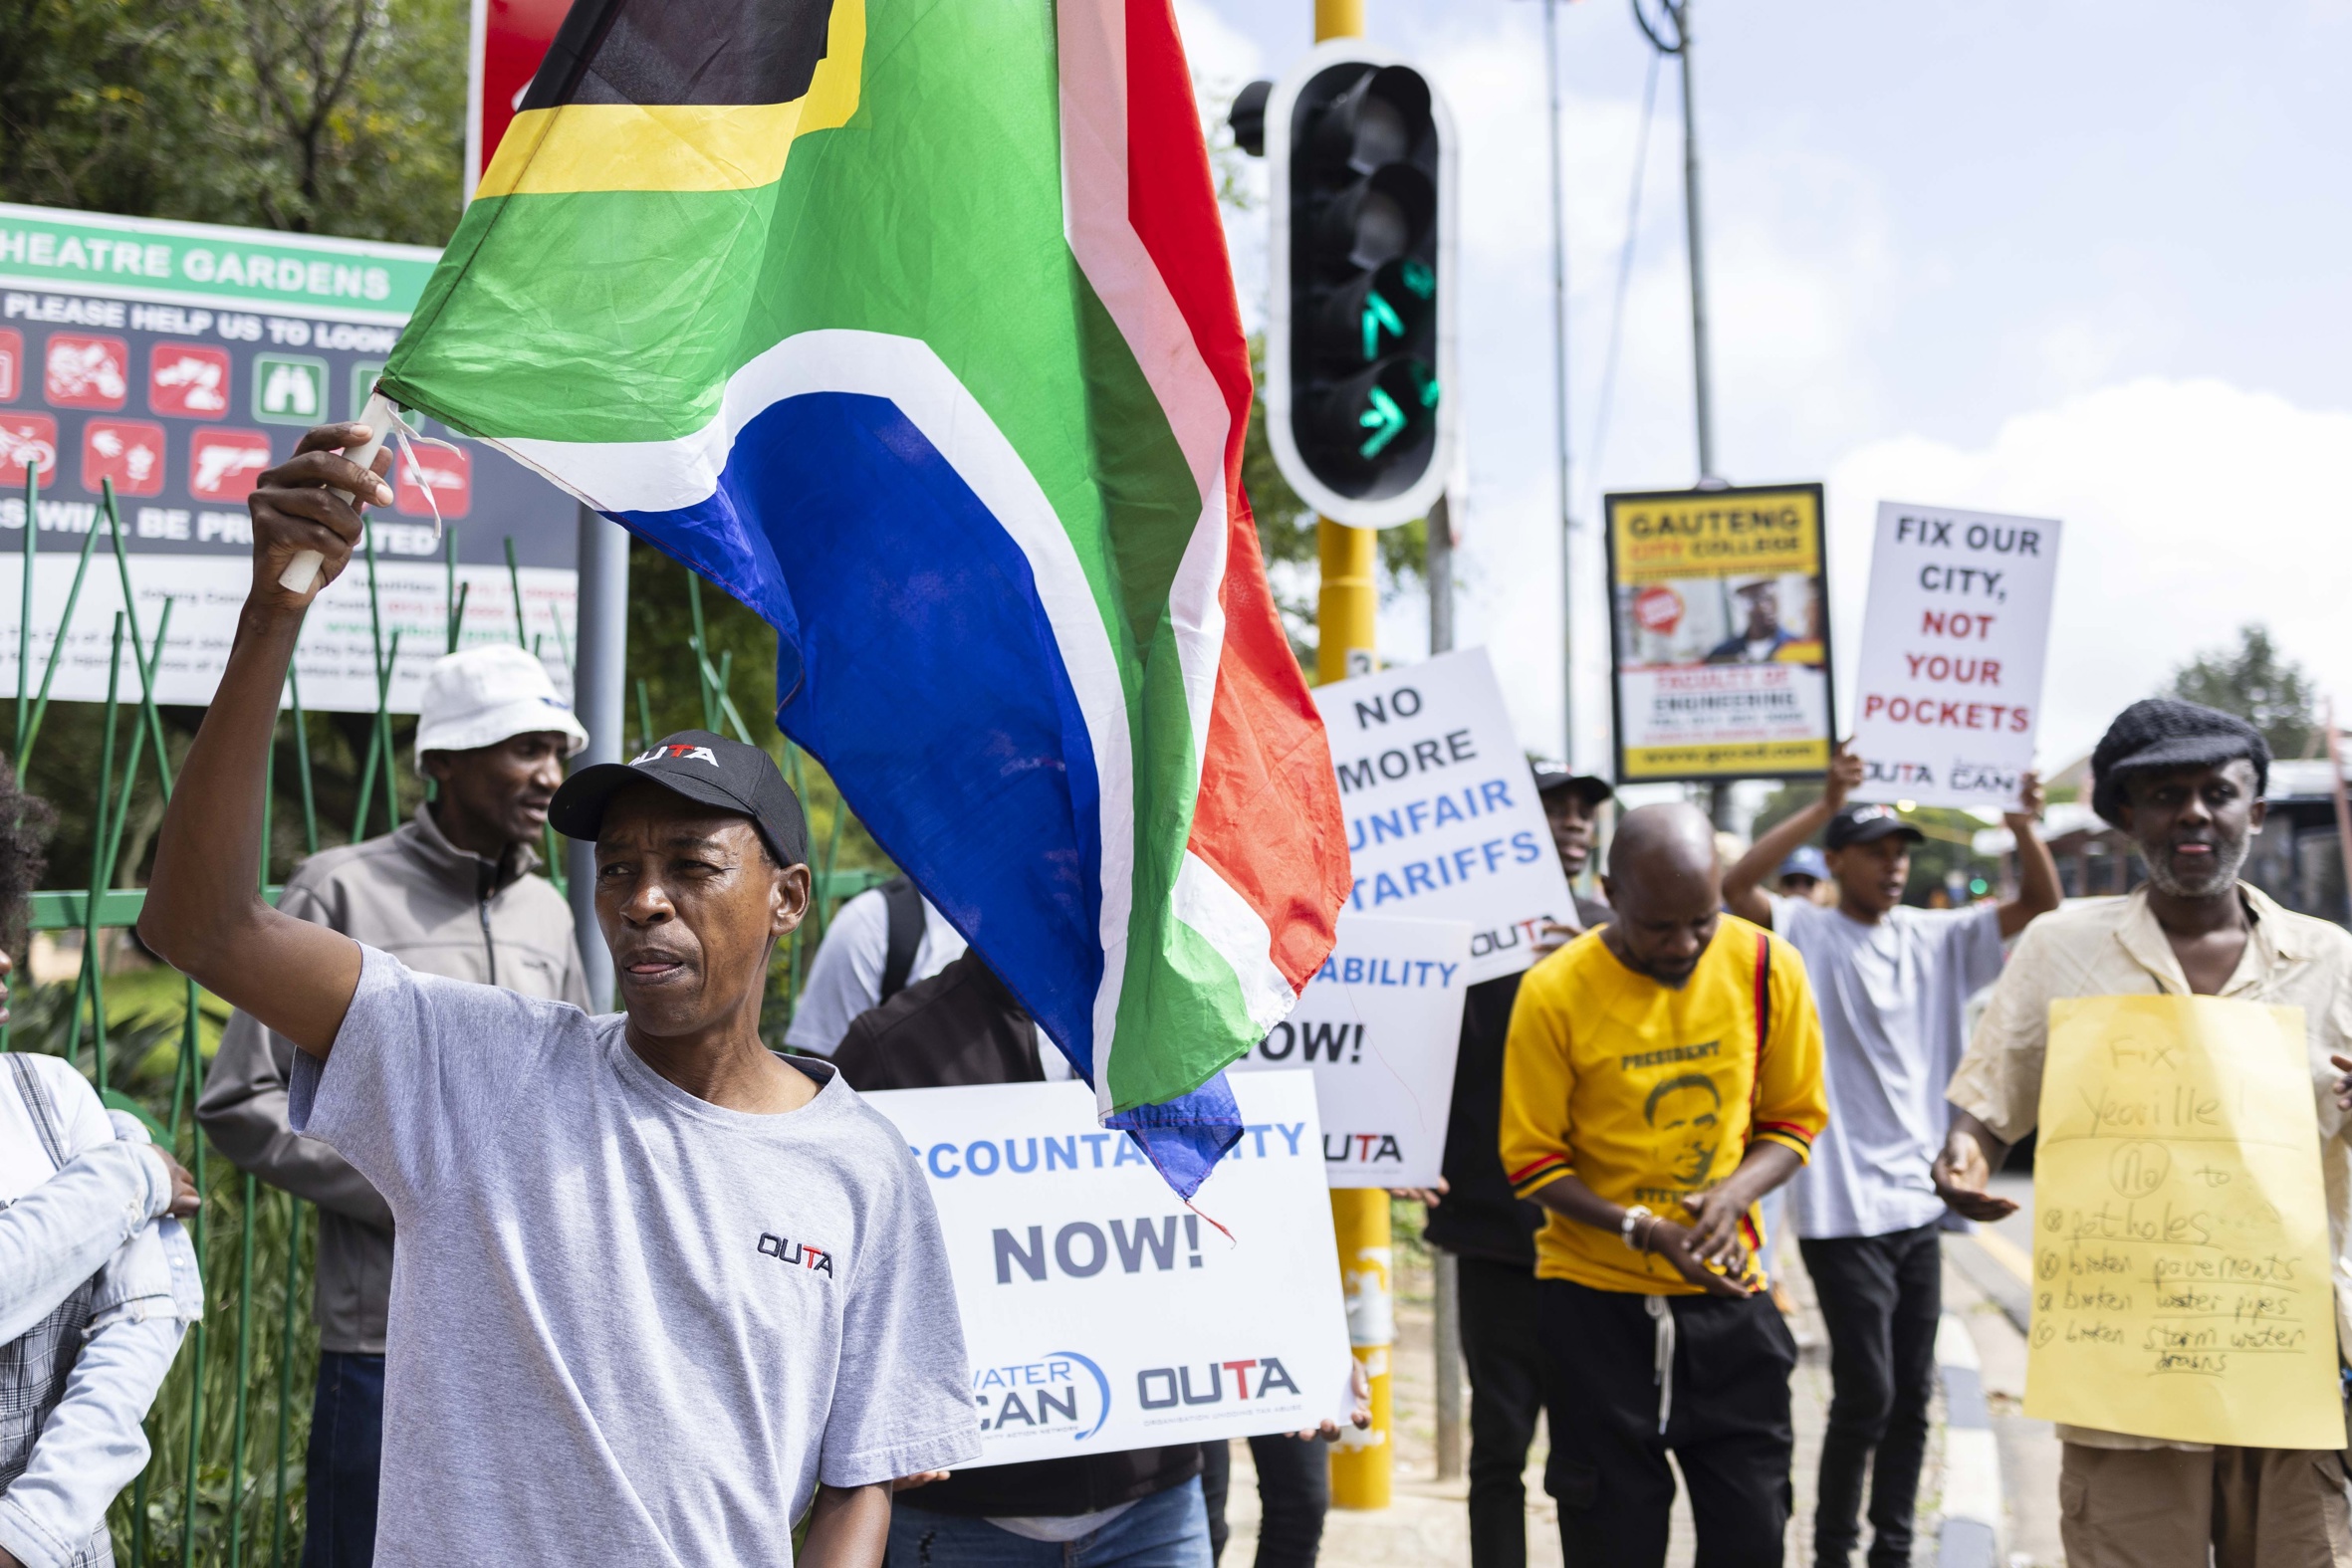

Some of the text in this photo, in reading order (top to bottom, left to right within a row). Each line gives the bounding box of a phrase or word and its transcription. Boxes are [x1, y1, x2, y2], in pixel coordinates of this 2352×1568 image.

[181, 247, 391, 301] GARDENS
[4, 293, 398, 353] PLEASE HELP US TO LOOK
[137, 506, 191, 541] BE
[1627, 504, 1800, 539] GAUTENG
[1896, 516, 2041, 557] FIX OUR
[1629, 537, 1799, 560] CITY COLLEGE
[1919, 563, 2007, 604] CITY,
[1922, 609, 1996, 640] NOT
[1905, 652, 2001, 686] YOUR
[1353, 687, 1422, 730] NO
[1863, 694, 2030, 733] POCKETS
[1336, 728, 1478, 793] MORE
[1350, 830, 1541, 912] TARIFFS
[1472, 915, 1557, 958] OUT
[1240, 1020, 1365, 1064] OW!
[1621, 1038, 1722, 1072] PRESIDENT
[2108, 1033, 2178, 1071] Fix
[2068, 1201, 2213, 1249] potholes
[757, 1232, 833, 1279] OUTA
[992, 1214, 1204, 1285] NOW!
[2068, 1244, 2134, 1276] broken
[2062, 1278, 2291, 1326] broken water pipes
[2064, 1318, 2126, 1345] broken
[2231, 1324, 2306, 1349] water
[973, 1357, 1302, 1411] ATER OUTA
